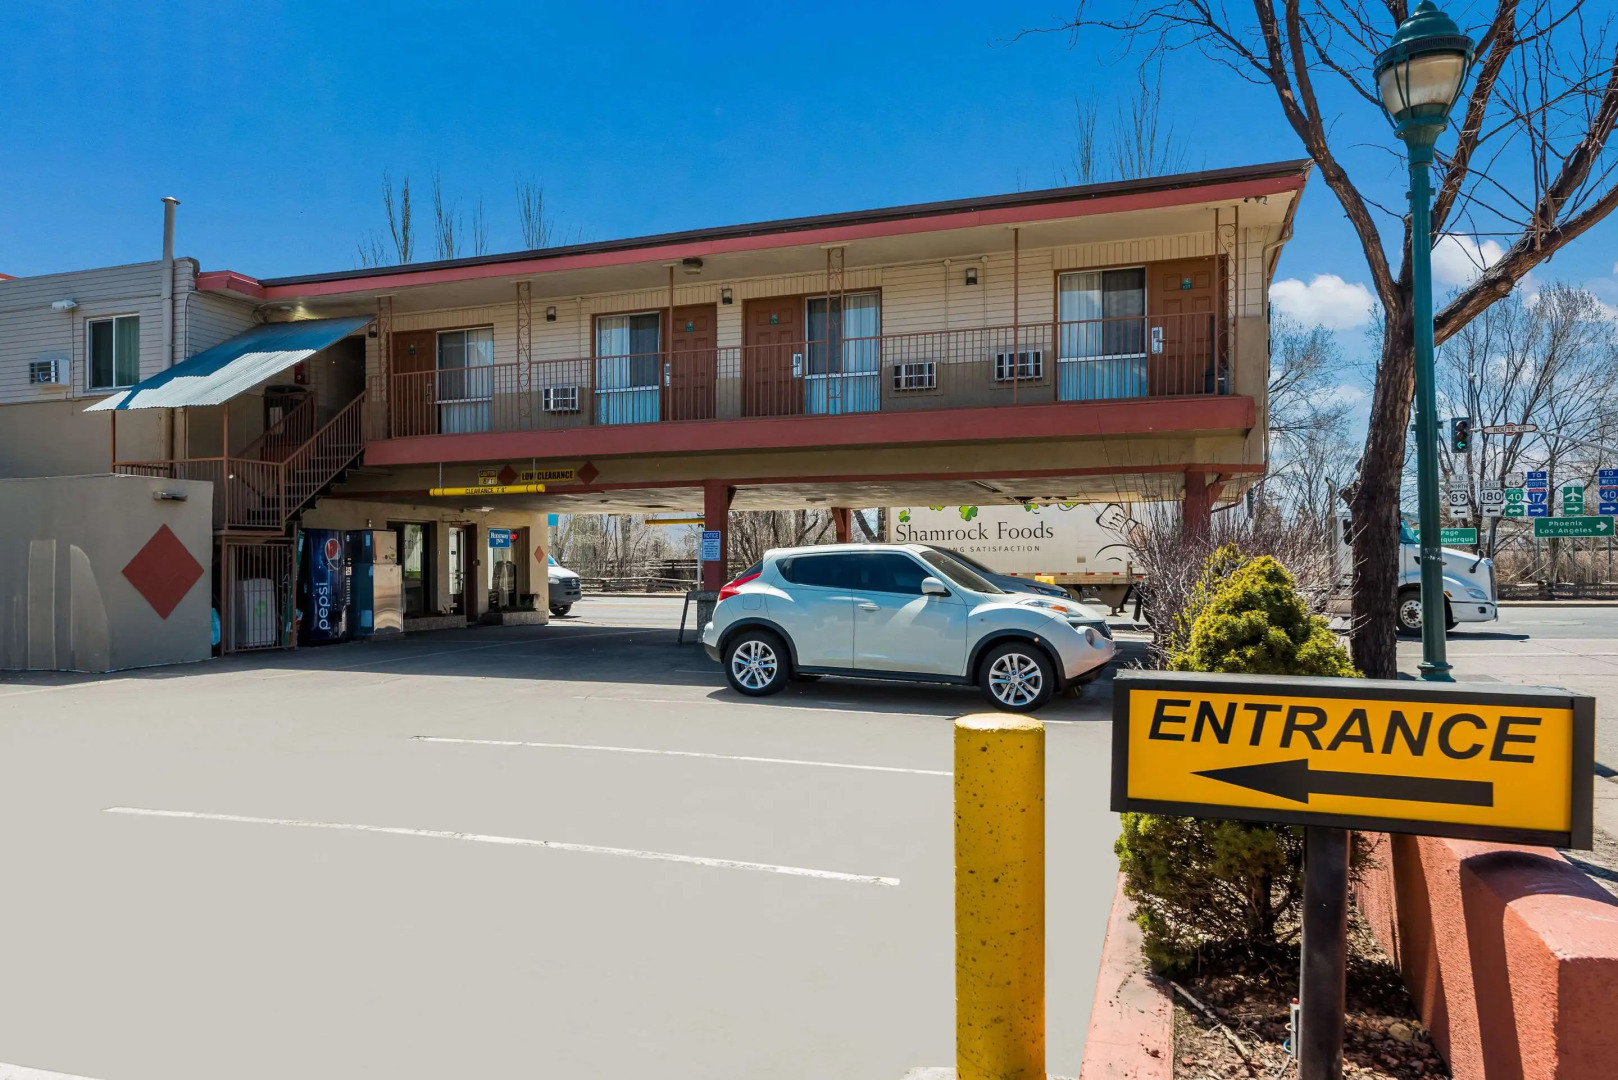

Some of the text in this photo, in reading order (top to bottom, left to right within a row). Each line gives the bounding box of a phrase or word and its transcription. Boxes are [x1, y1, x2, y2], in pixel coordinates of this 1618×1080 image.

[522, 470, 573, 480] LOW CLEARANCE
[1451, 493, 1466, 502] 89
[1482, 492, 1501, 500] 180
[1532, 493, 1543, 502] 17
[1601, 490, 1617, 499] 40
[896, 520, 1054, 542] Shamrock Foods
[1558, 527, 1593, 535] Angeles
[969, 545, 1041, 553] SATISFACTION
[316, 582, 331, 630] pepsi
[1148, 698, 1542, 764] ENTRANCE
